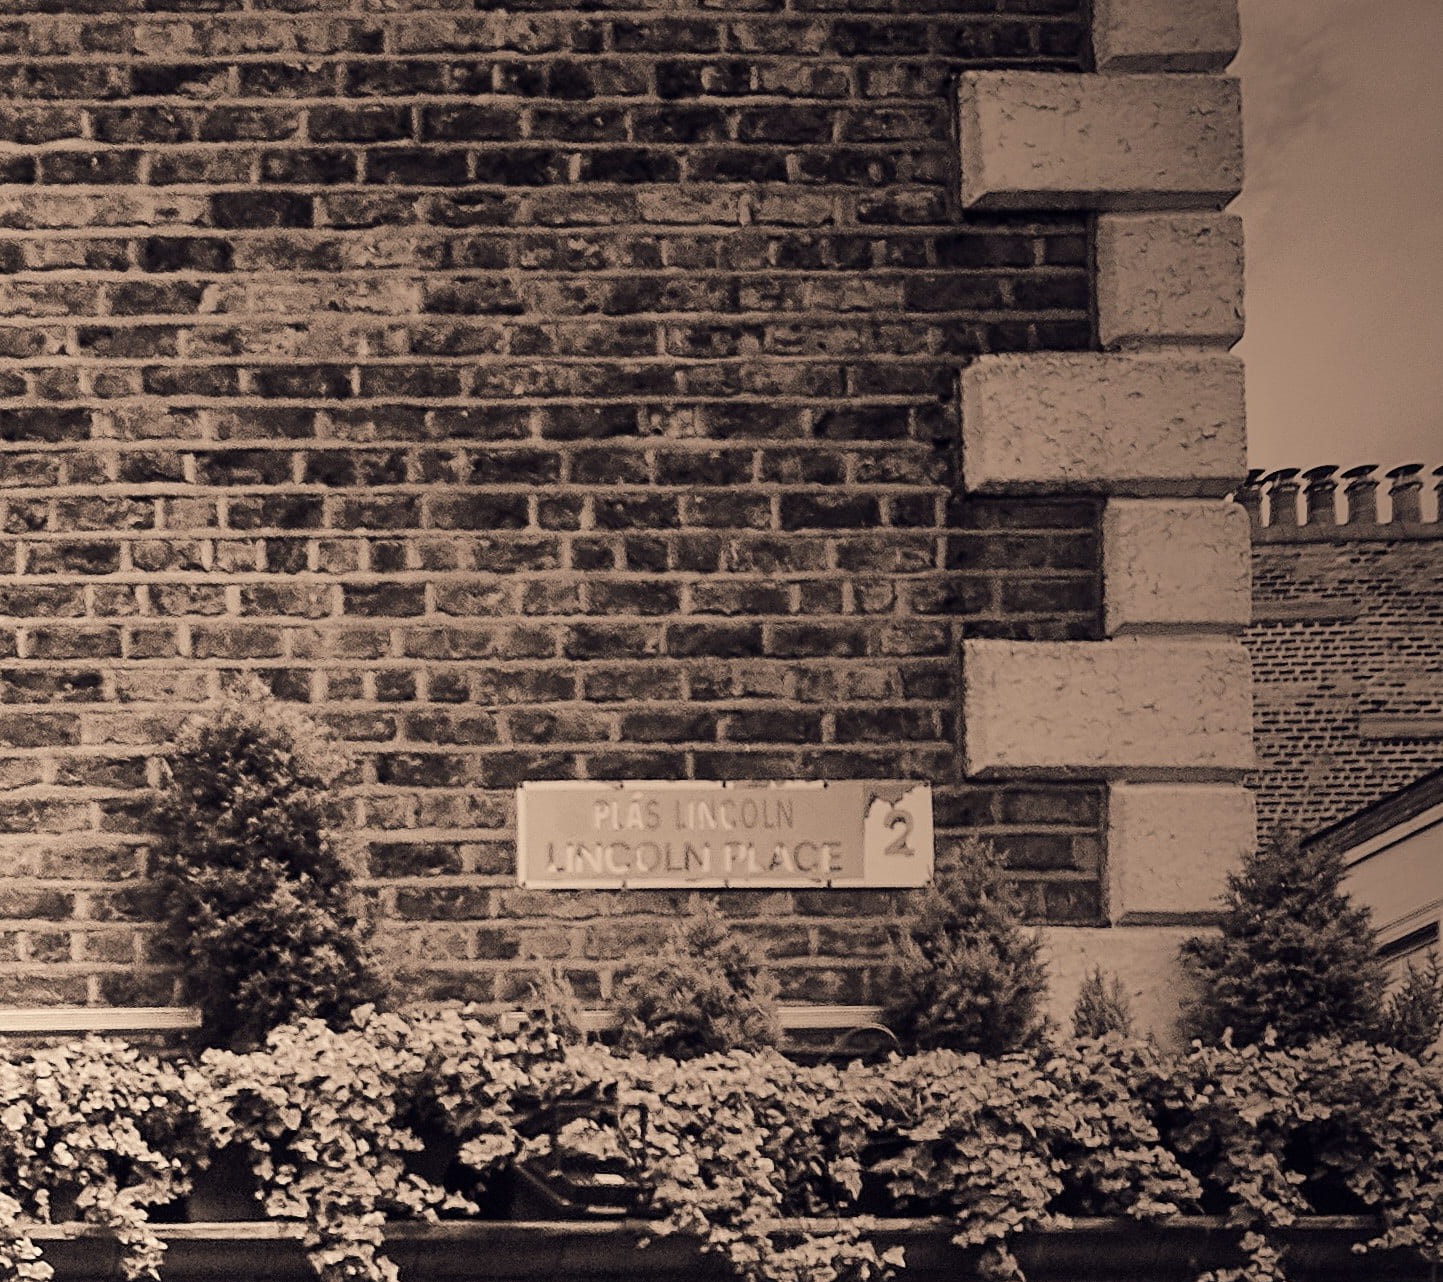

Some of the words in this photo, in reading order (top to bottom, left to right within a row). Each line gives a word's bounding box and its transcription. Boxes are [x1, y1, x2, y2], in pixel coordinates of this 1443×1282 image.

[594, 793, 660, 830] PLÁS
[674, 799, 794, 829] LINCOLN
[883, 810, 916, 857] 2
[547, 841, 710, 873] LINCOLN
[724, 840, 844, 873] PLACE
